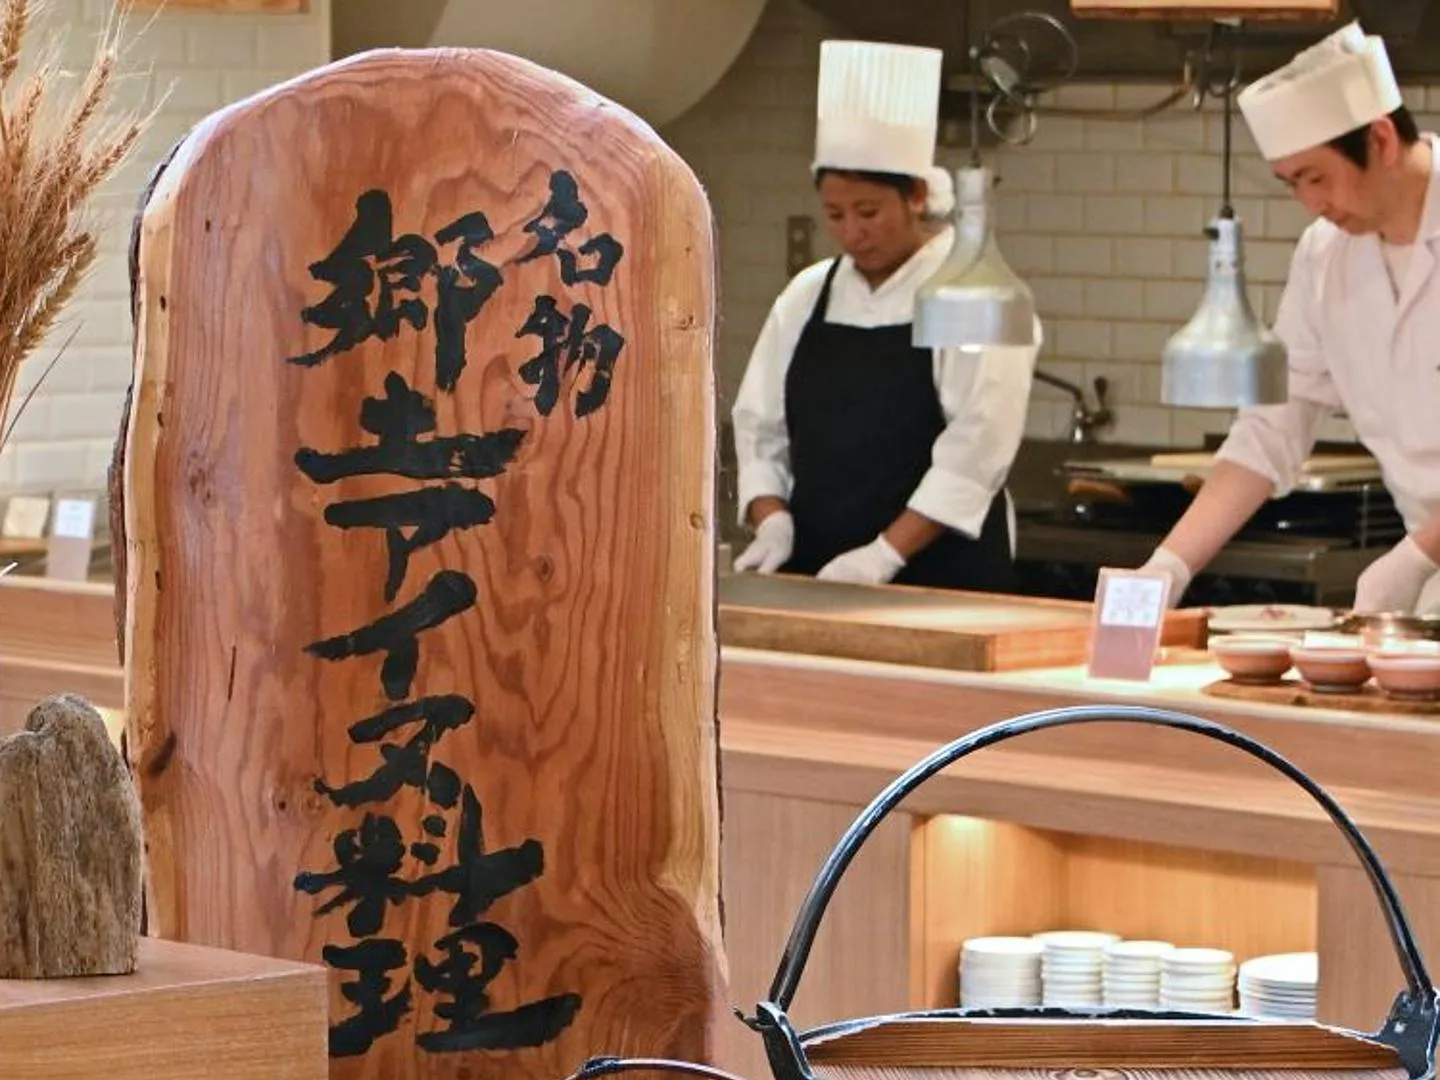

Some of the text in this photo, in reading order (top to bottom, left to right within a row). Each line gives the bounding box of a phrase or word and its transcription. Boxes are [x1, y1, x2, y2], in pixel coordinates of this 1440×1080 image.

[514, 169, 625, 418] 名物
[287, 189, 580, 1057] 郷土アイヌ料理
